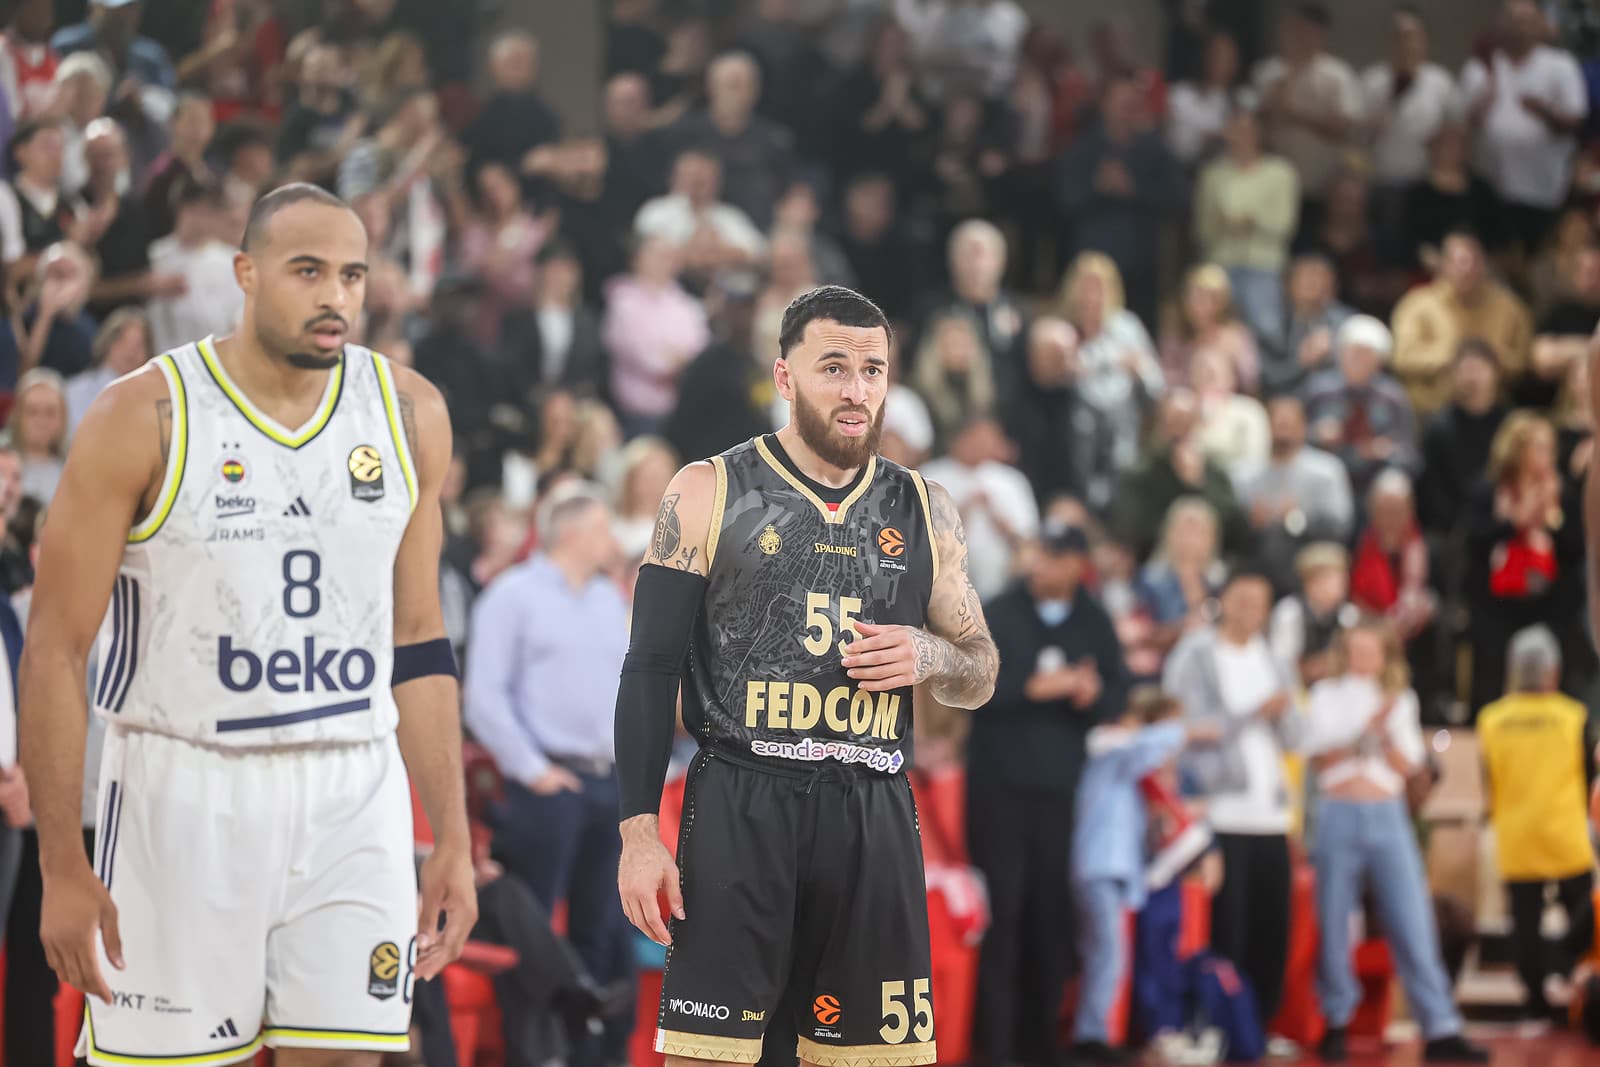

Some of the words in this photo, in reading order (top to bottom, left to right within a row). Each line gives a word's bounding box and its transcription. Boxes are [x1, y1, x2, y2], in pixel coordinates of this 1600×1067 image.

[215, 495, 255, 508] beko
[814, 543, 857, 558] SPALDING
[283, 549, 321, 619] 8
[803, 591, 863, 658] 55
[218, 636, 375, 693] beko
[745, 681, 901, 740] FEDCOM
[752, 739, 889, 770] zondacrypto
[879, 978, 934, 1045] 55
